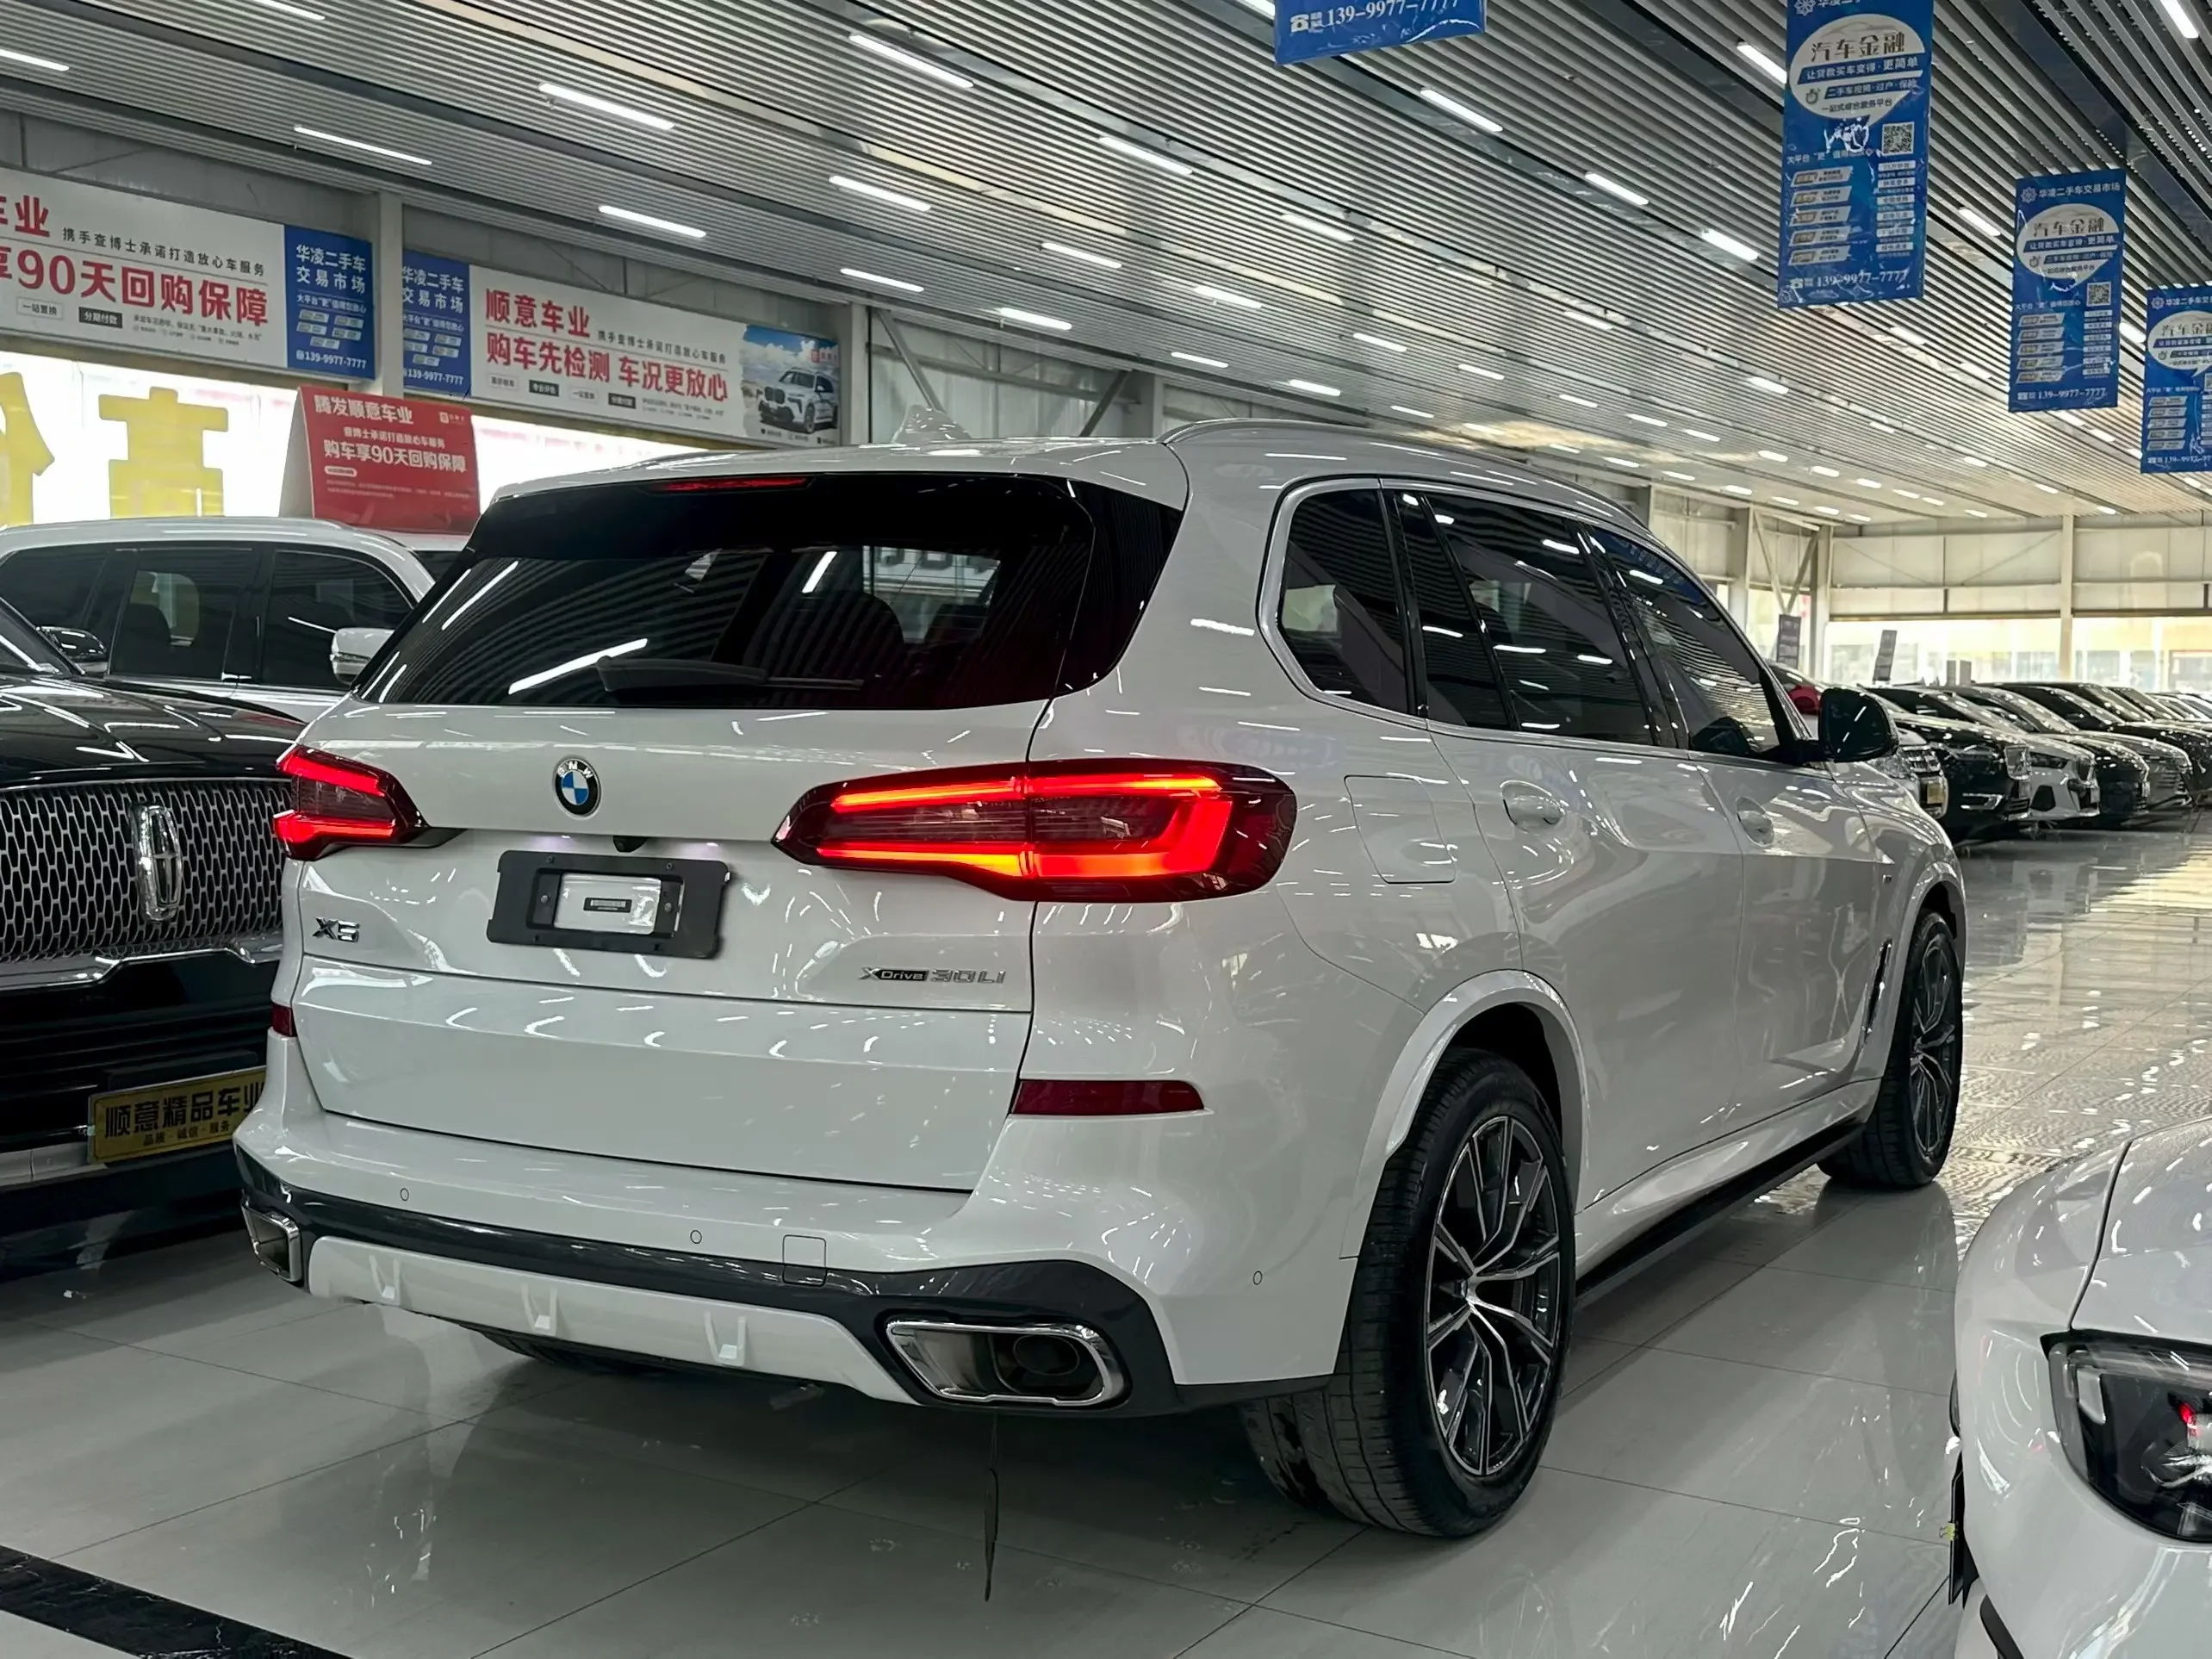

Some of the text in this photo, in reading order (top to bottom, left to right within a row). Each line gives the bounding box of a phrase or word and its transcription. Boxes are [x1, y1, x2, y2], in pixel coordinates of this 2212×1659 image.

[1811, 32, 1905, 62] 汽车金融
[0, 195, 50, 238] 业
[62, 227, 265, 277] 携手查博士承诺打造放心车服务
[295, 244, 366, 273] 华凌二手车
[296, 265, 365, 294] 交易市场
[403, 287, 463, 314] 交易市场
[486, 289, 590, 339] 顺意车业
[487, 332, 610, 383] 购车先检测
[618, 356, 728, 402] 车况更放心
[323, 439, 467, 473] 购车享90天回购保障
[556, 761, 593, 779] BMW
